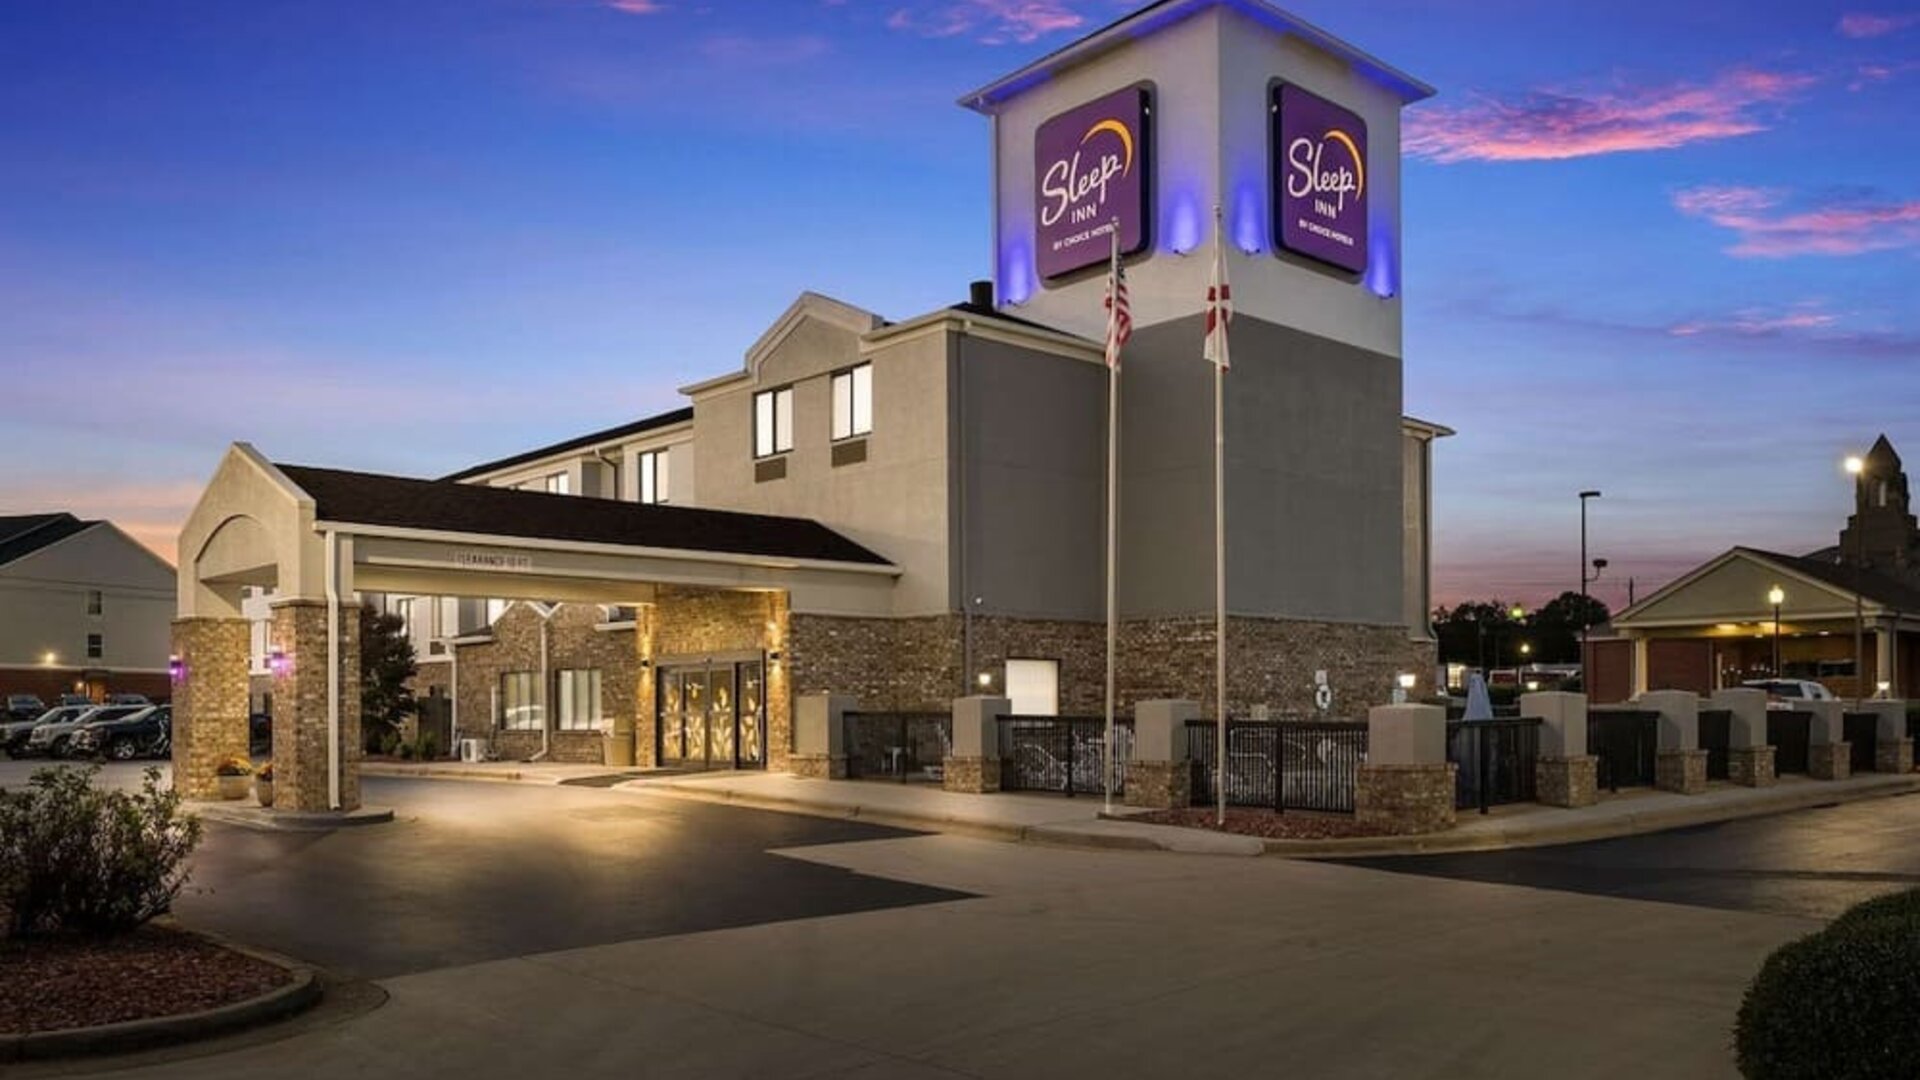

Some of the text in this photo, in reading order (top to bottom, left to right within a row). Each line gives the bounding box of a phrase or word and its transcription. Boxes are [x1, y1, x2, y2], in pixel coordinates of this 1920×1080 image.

[1288, 138, 1356, 211] Sleep
[1041, 150, 1122, 226] Sleep
[1071, 202, 1097, 224] INN
[1315, 199, 1337, 219] INN
[1063, 230, 1090, 247] CHOICE
[1309, 222, 1331, 238] CHOICE
[1331, 231, 1354, 246] HOTELS
